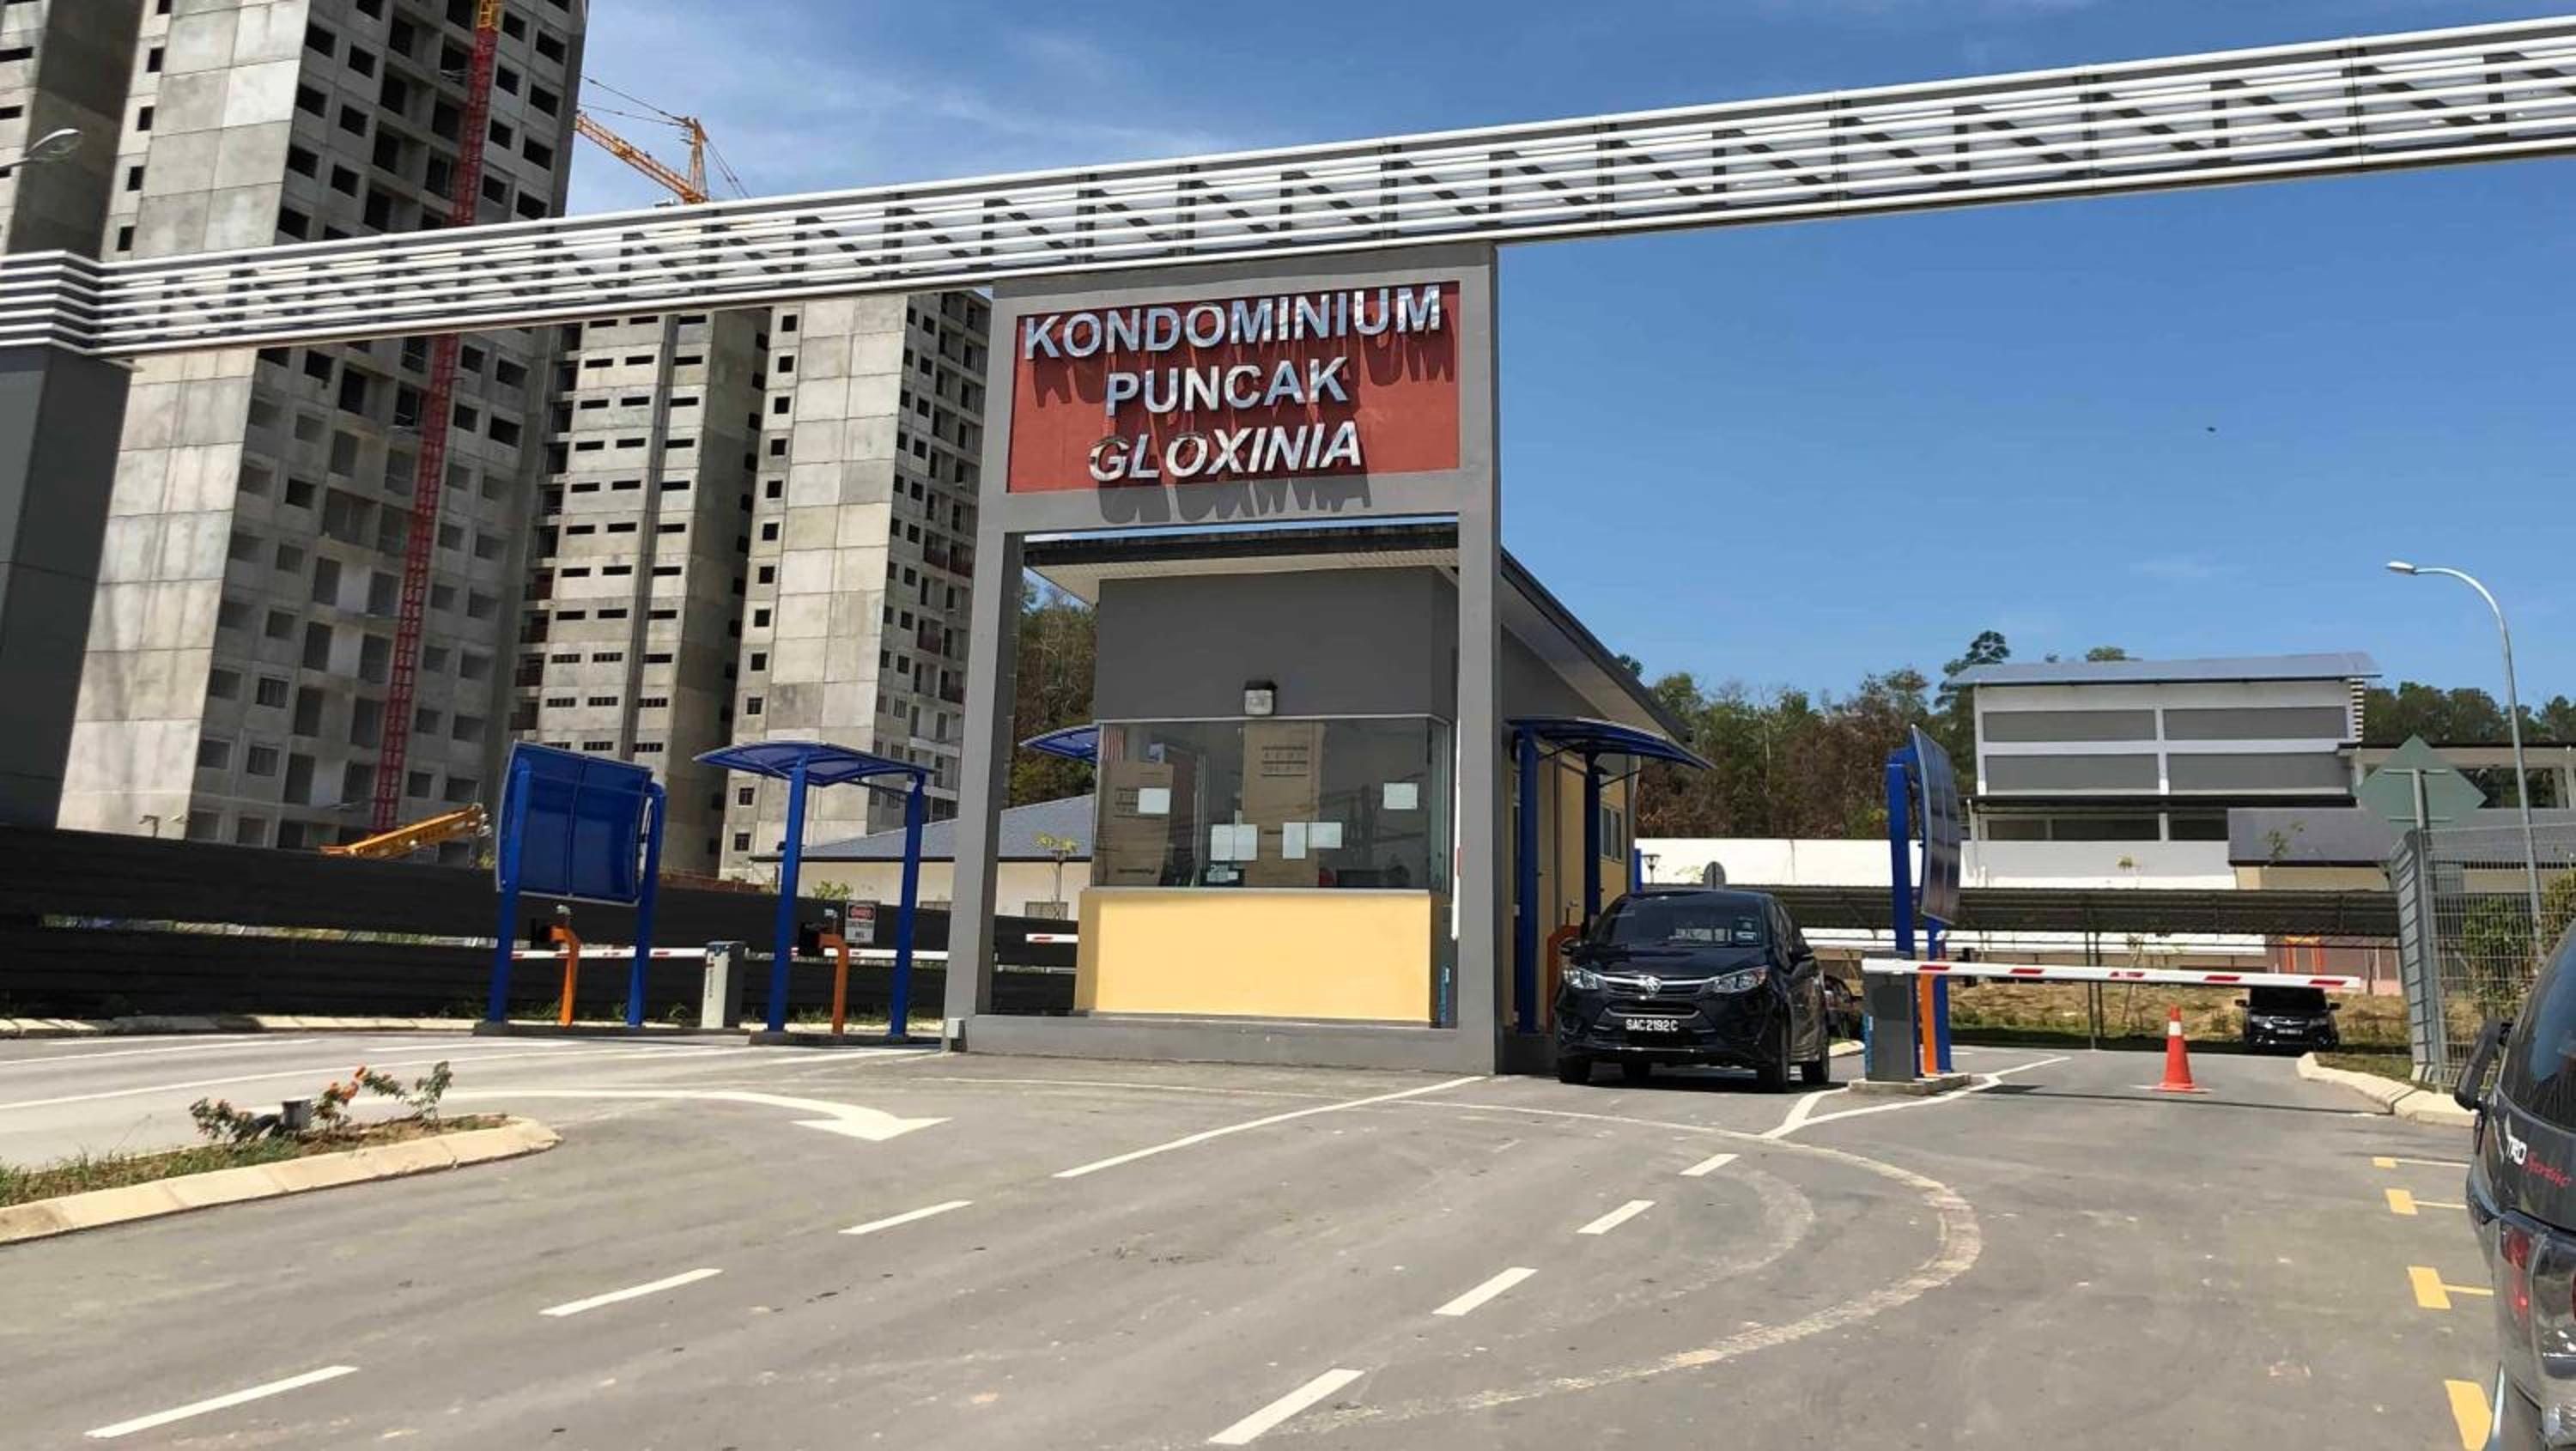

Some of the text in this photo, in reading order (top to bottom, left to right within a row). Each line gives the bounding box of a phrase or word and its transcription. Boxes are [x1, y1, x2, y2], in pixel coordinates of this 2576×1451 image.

[1024, 284, 1441, 361] KONDOMINIUM
[1106, 356, 1348, 417] PUNCAK
[1088, 421, 1362, 483] GLOXINIA
